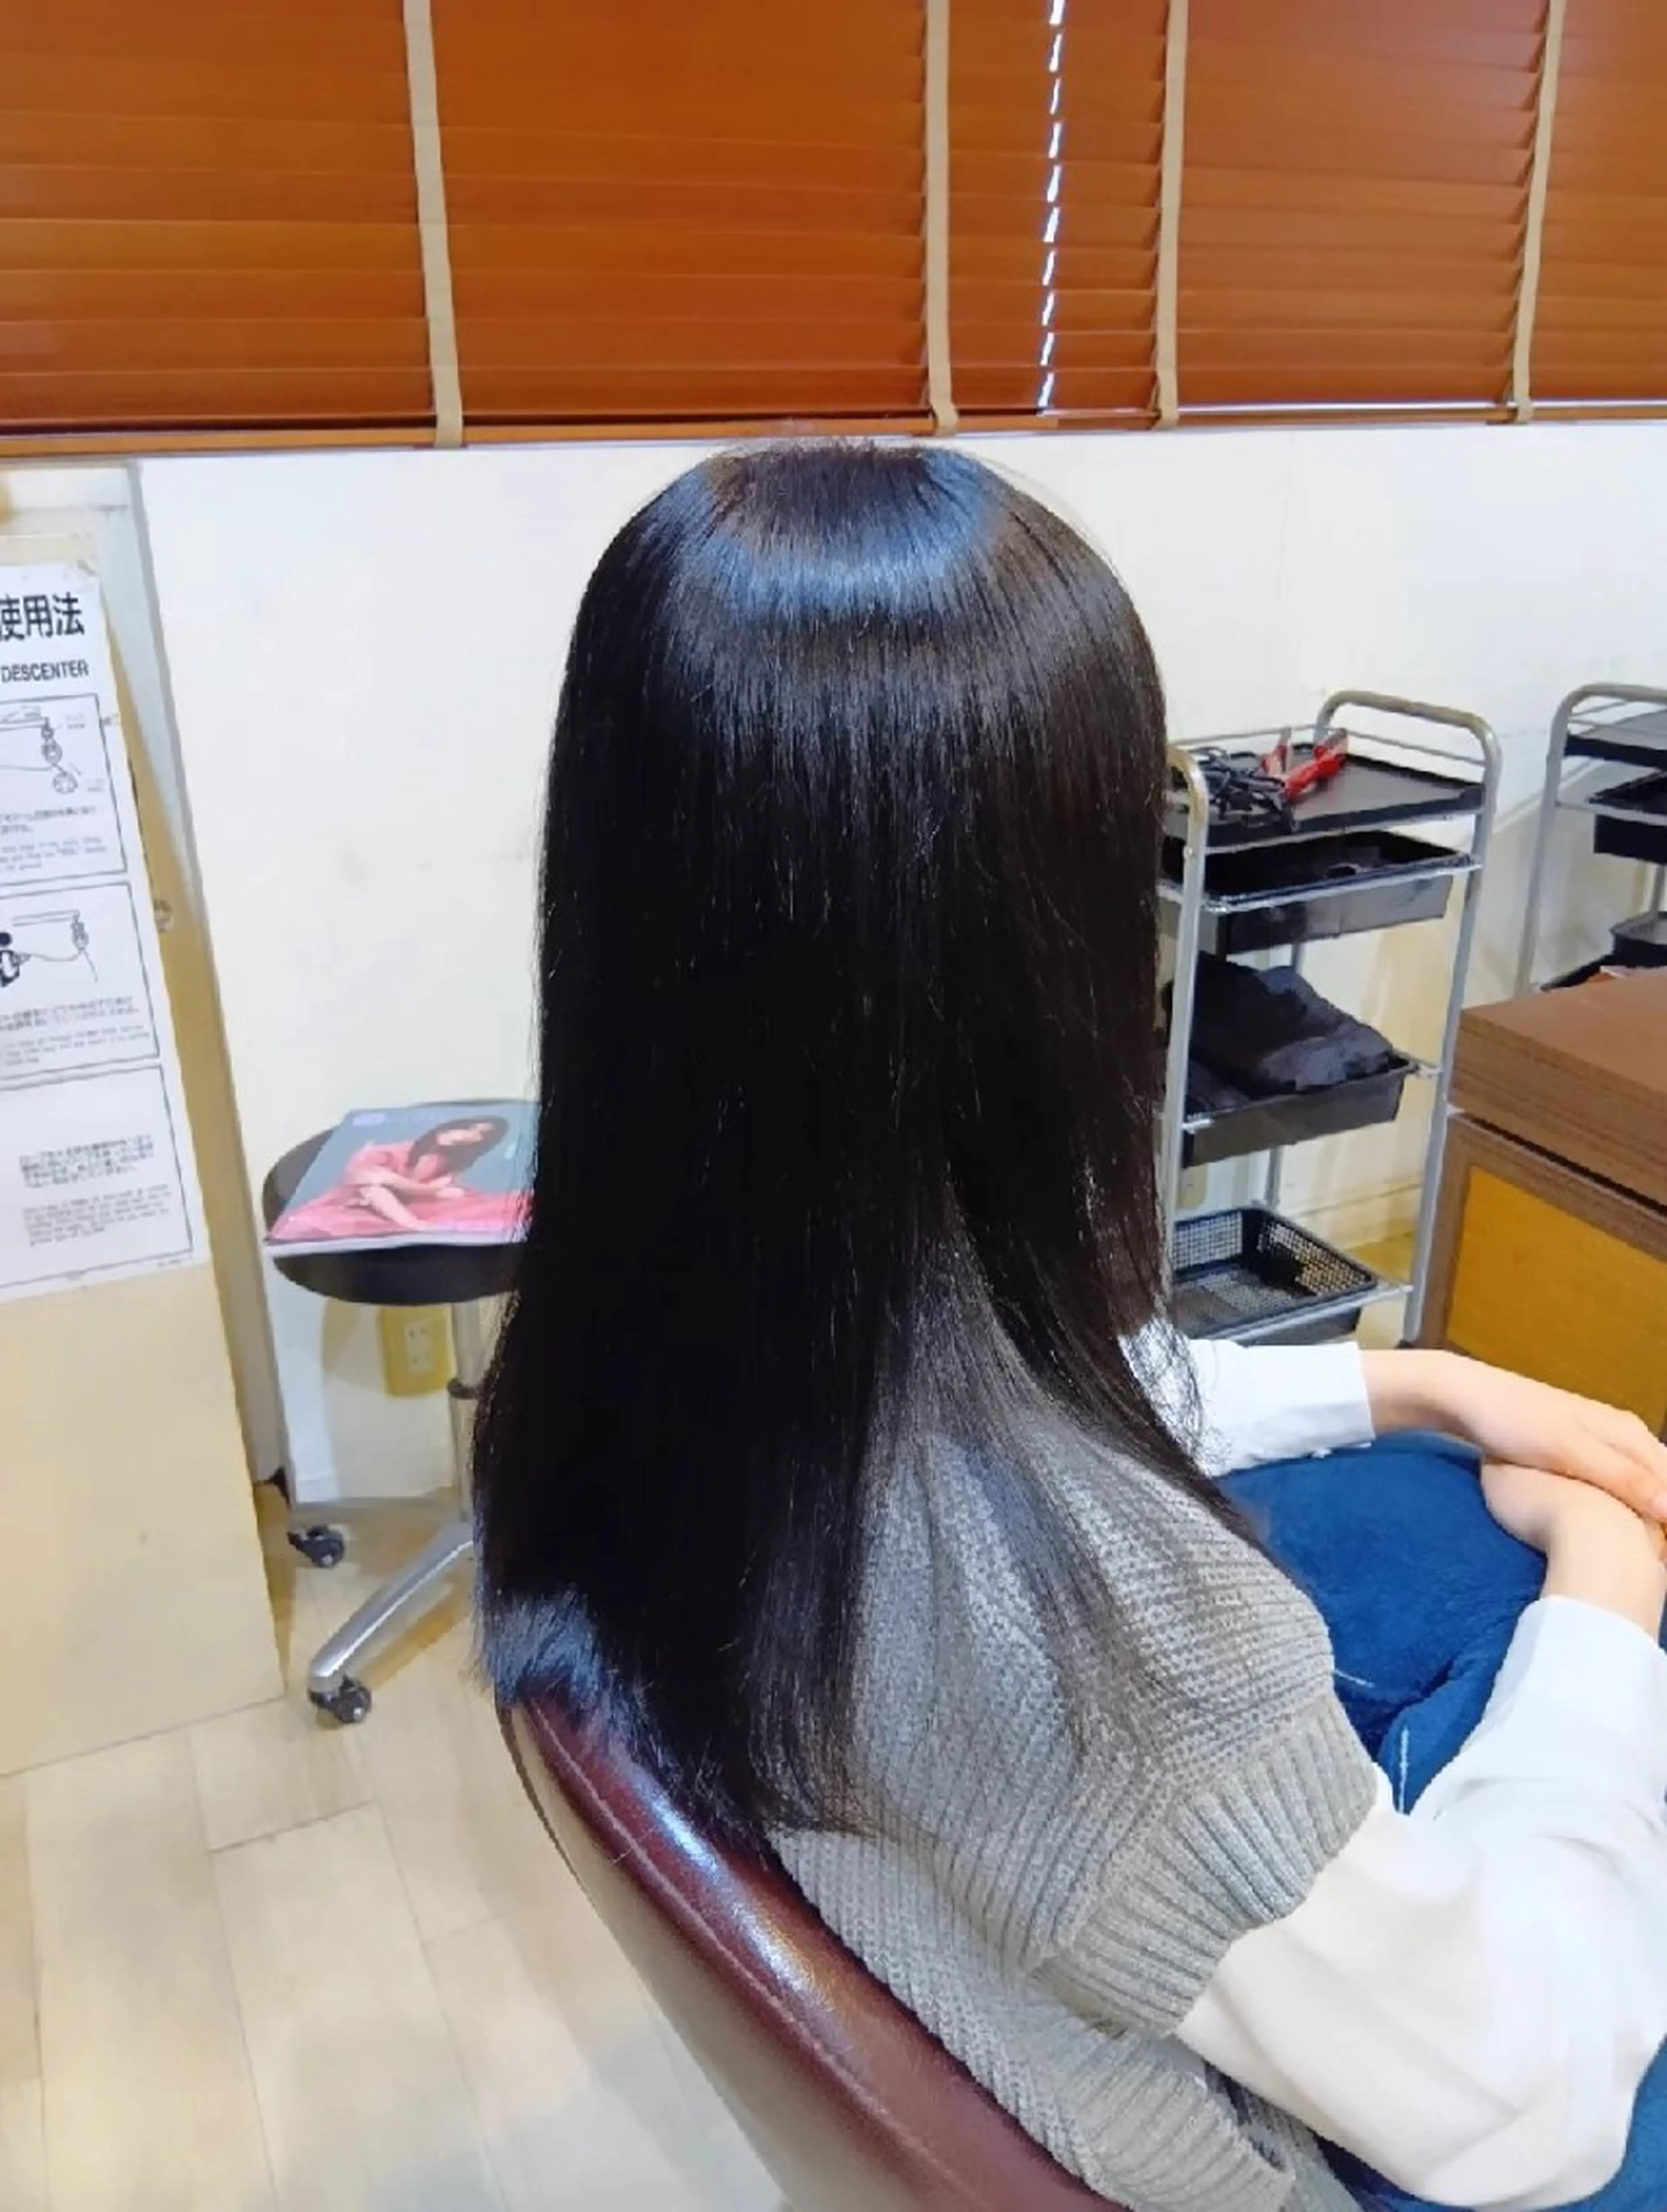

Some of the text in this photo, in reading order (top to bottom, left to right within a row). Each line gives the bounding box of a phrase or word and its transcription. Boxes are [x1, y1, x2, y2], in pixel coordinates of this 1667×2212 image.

[0, 592, 85, 642] 使用法
[1, 658, 89, 683] DESCENTER
